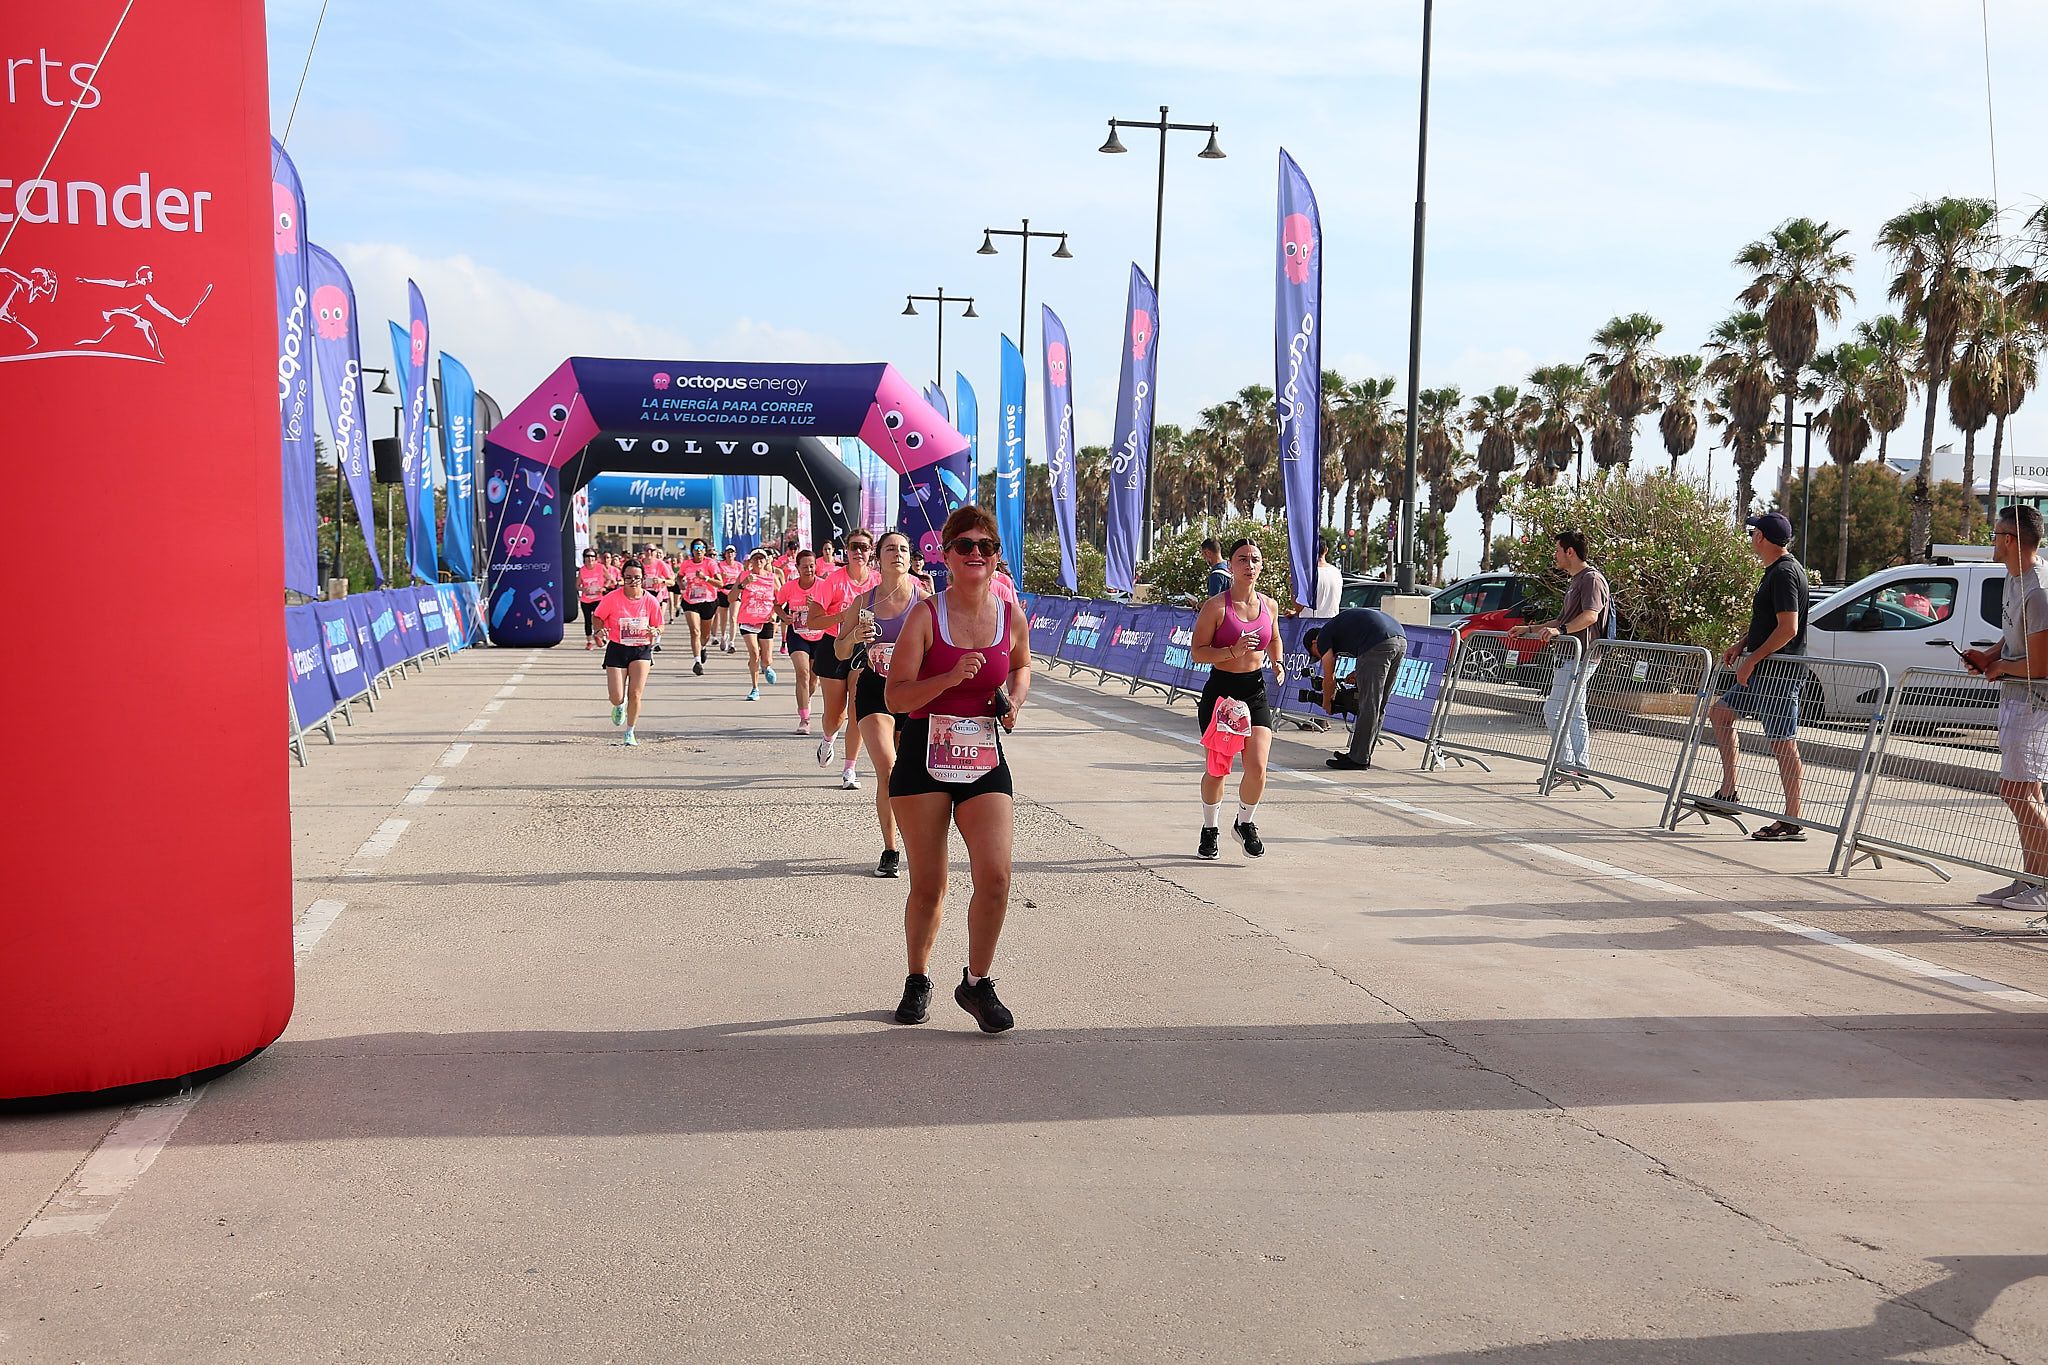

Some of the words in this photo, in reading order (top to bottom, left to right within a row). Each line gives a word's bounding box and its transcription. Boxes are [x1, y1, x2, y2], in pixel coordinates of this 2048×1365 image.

[676, 374, 747, 393] octopus
[749, 377, 808, 396] energy
[641, 398, 659, 408] LA
[662, 397, 719, 410] ENERGÍA
[722, 400, 757, 412] PARA
[760, 401, 813, 413] CORRER
[640, 411, 650, 421] A
[653, 412, 669, 422] LA
[673, 413, 748, 424] VELOCIDAD
[750, 415, 768, 424] DE
[770, 415, 787, 425] LA
[790, 416, 816, 425] LUZ
[614, 437, 770, 456] VOLVO
[2014, 466, 2026, 476] EL
[629, 479, 686, 504] Marlene
[523, 562, 551, 573] energy
[951, 745, 979, 758] 016
